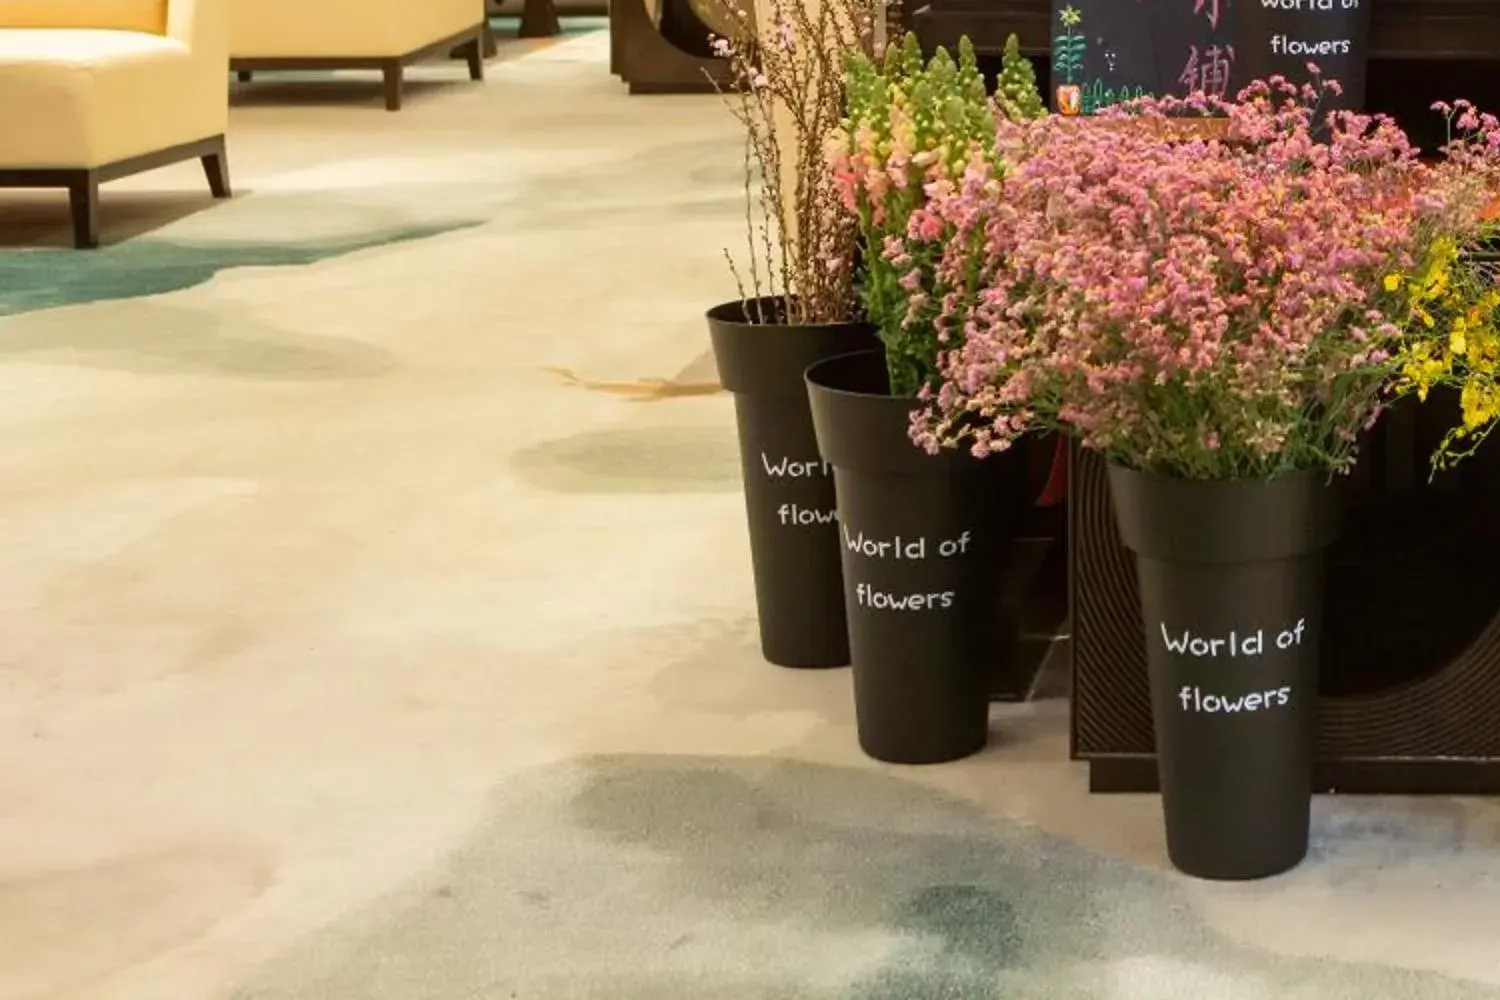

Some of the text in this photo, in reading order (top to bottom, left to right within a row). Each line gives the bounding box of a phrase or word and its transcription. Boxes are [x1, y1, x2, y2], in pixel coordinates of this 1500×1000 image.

[1269, 34, 1351, 55] flowers
[761, 451, 829, 477] Worl
[777, 503, 839, 526] flow
[843, 523, 971, 559] World of
[856, 582, 955, 610] flowers
[1160, 617, 1305, 657] World of
[1178, 685, 1291, 713] flowers
